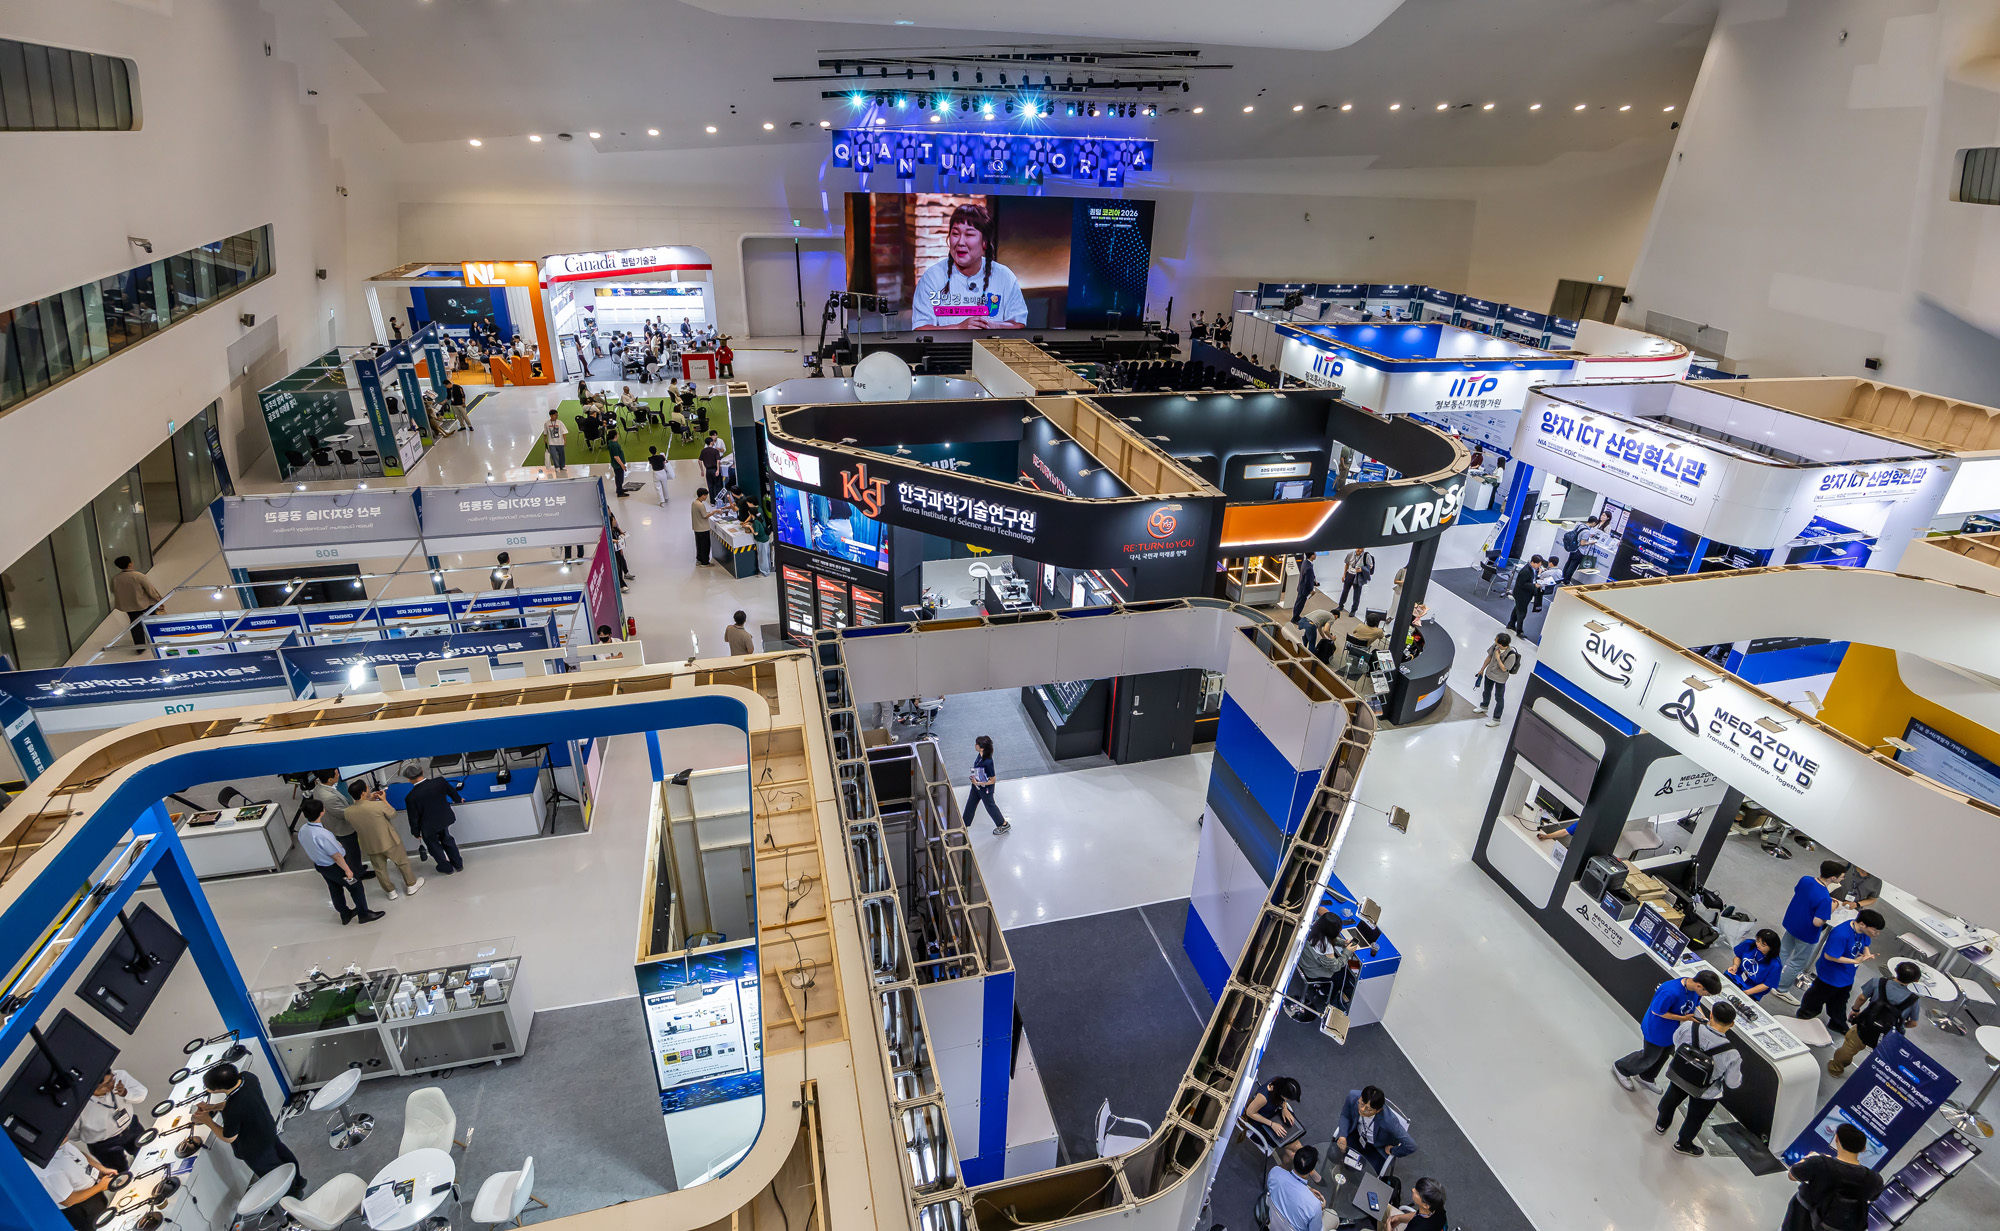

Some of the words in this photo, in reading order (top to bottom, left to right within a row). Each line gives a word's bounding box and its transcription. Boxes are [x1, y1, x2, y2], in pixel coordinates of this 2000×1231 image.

[466, 263, 506, 286] NL
[565, 254, 617, 274] Canada
[621, 254, 657, 268] 퀀텀기술관
[1230, 366, 1254, 383] QUANTUM
[1435, 399, 1502, 410] 정보통신기획평가원
[1540, 411, 1574, 442] 양자
[1575, 422, 1605, 450] ICT
[1604, 432, 1708, 488] 산업혁신관
[840, 462, 890, 518] KIST
[1819, 473, 1847, 491] 양자
[898, 481, 1037, 533] 한국과학기술연구원
[902, 504, 920, 515] Korea
[921, 508, 948, 522] Institute
[949, 514, 956, 523] of
[957, 518, 982, 530] Science
[983, 524, 996, 533] and
[997, 527, 1036, 543] Technology
[1123, 542, 1164, 553] RE:TURN
[1165, 541, 1175, 549] to
[1175, 539, 1195, 548] YOU
[1585, 632, 1635, 673] aws
[1708, 719, 1812, 789] CLOUD
[1714, 706, 1817, 775] MEGAZONE
[1680, 771, 1714, 782] MEGAZON
[1706, 732, 1736, 756] Transform
[1739, 752, 1771, 776] Tomorrow
[1775, 774, 1805, 796] Together
[1677, 776, 1718, 788] CLOUD
[1593, 912, 1624, 941] MEGAZONE
[1884, 1063, 1911, 1089] Quantum
